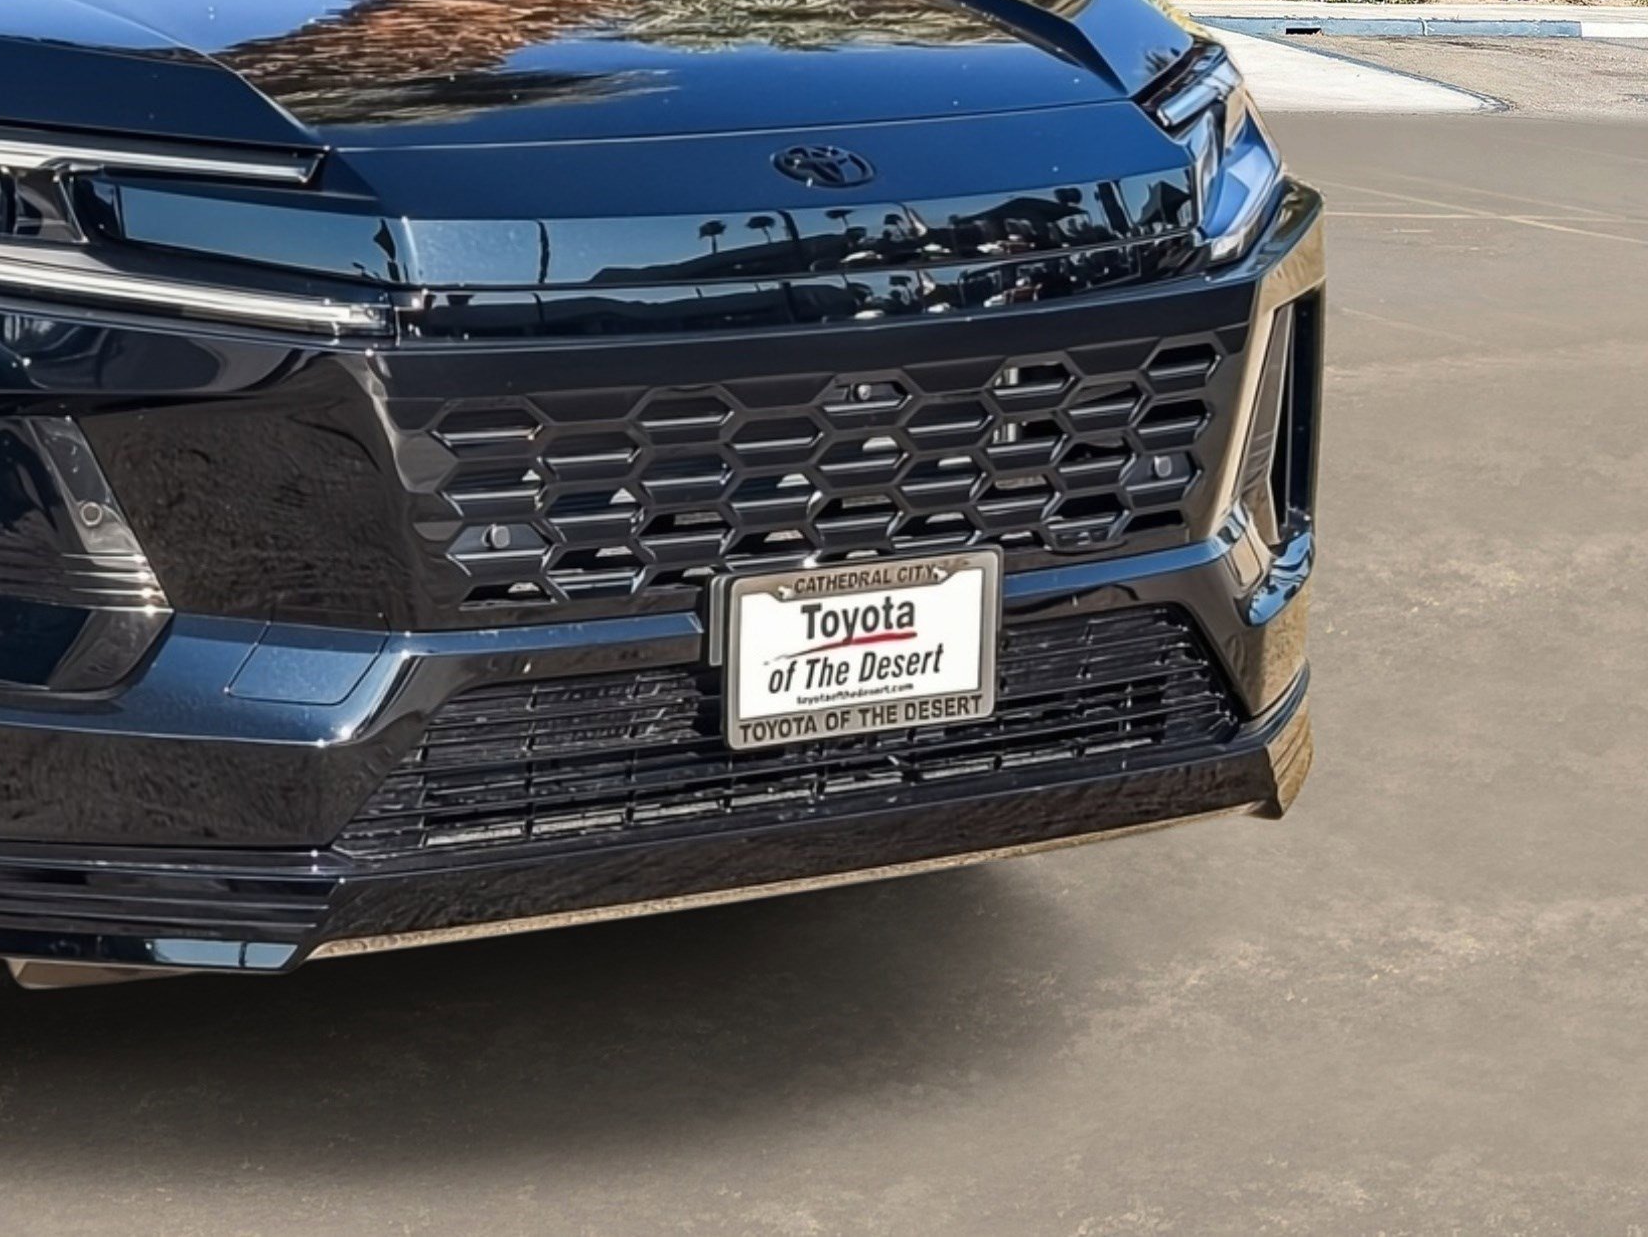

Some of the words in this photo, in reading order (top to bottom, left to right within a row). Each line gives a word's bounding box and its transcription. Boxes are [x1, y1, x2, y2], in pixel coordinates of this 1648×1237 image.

[793, 567, 892, 594] CATHEDRAL
[897, 563, 936, 583] CITY
[800, 595, 916, 643] Toyota
[768, 659, 799, 694] of
[804, 655, 850, 691] The
[858, 642, 945, 683] Desert
[738, 716, 818, 744] TOYOTA
[825, 711, 852, 731] OF
[857, 705, 898, 727] THE
[904, 694, 984, 721] DESERT
